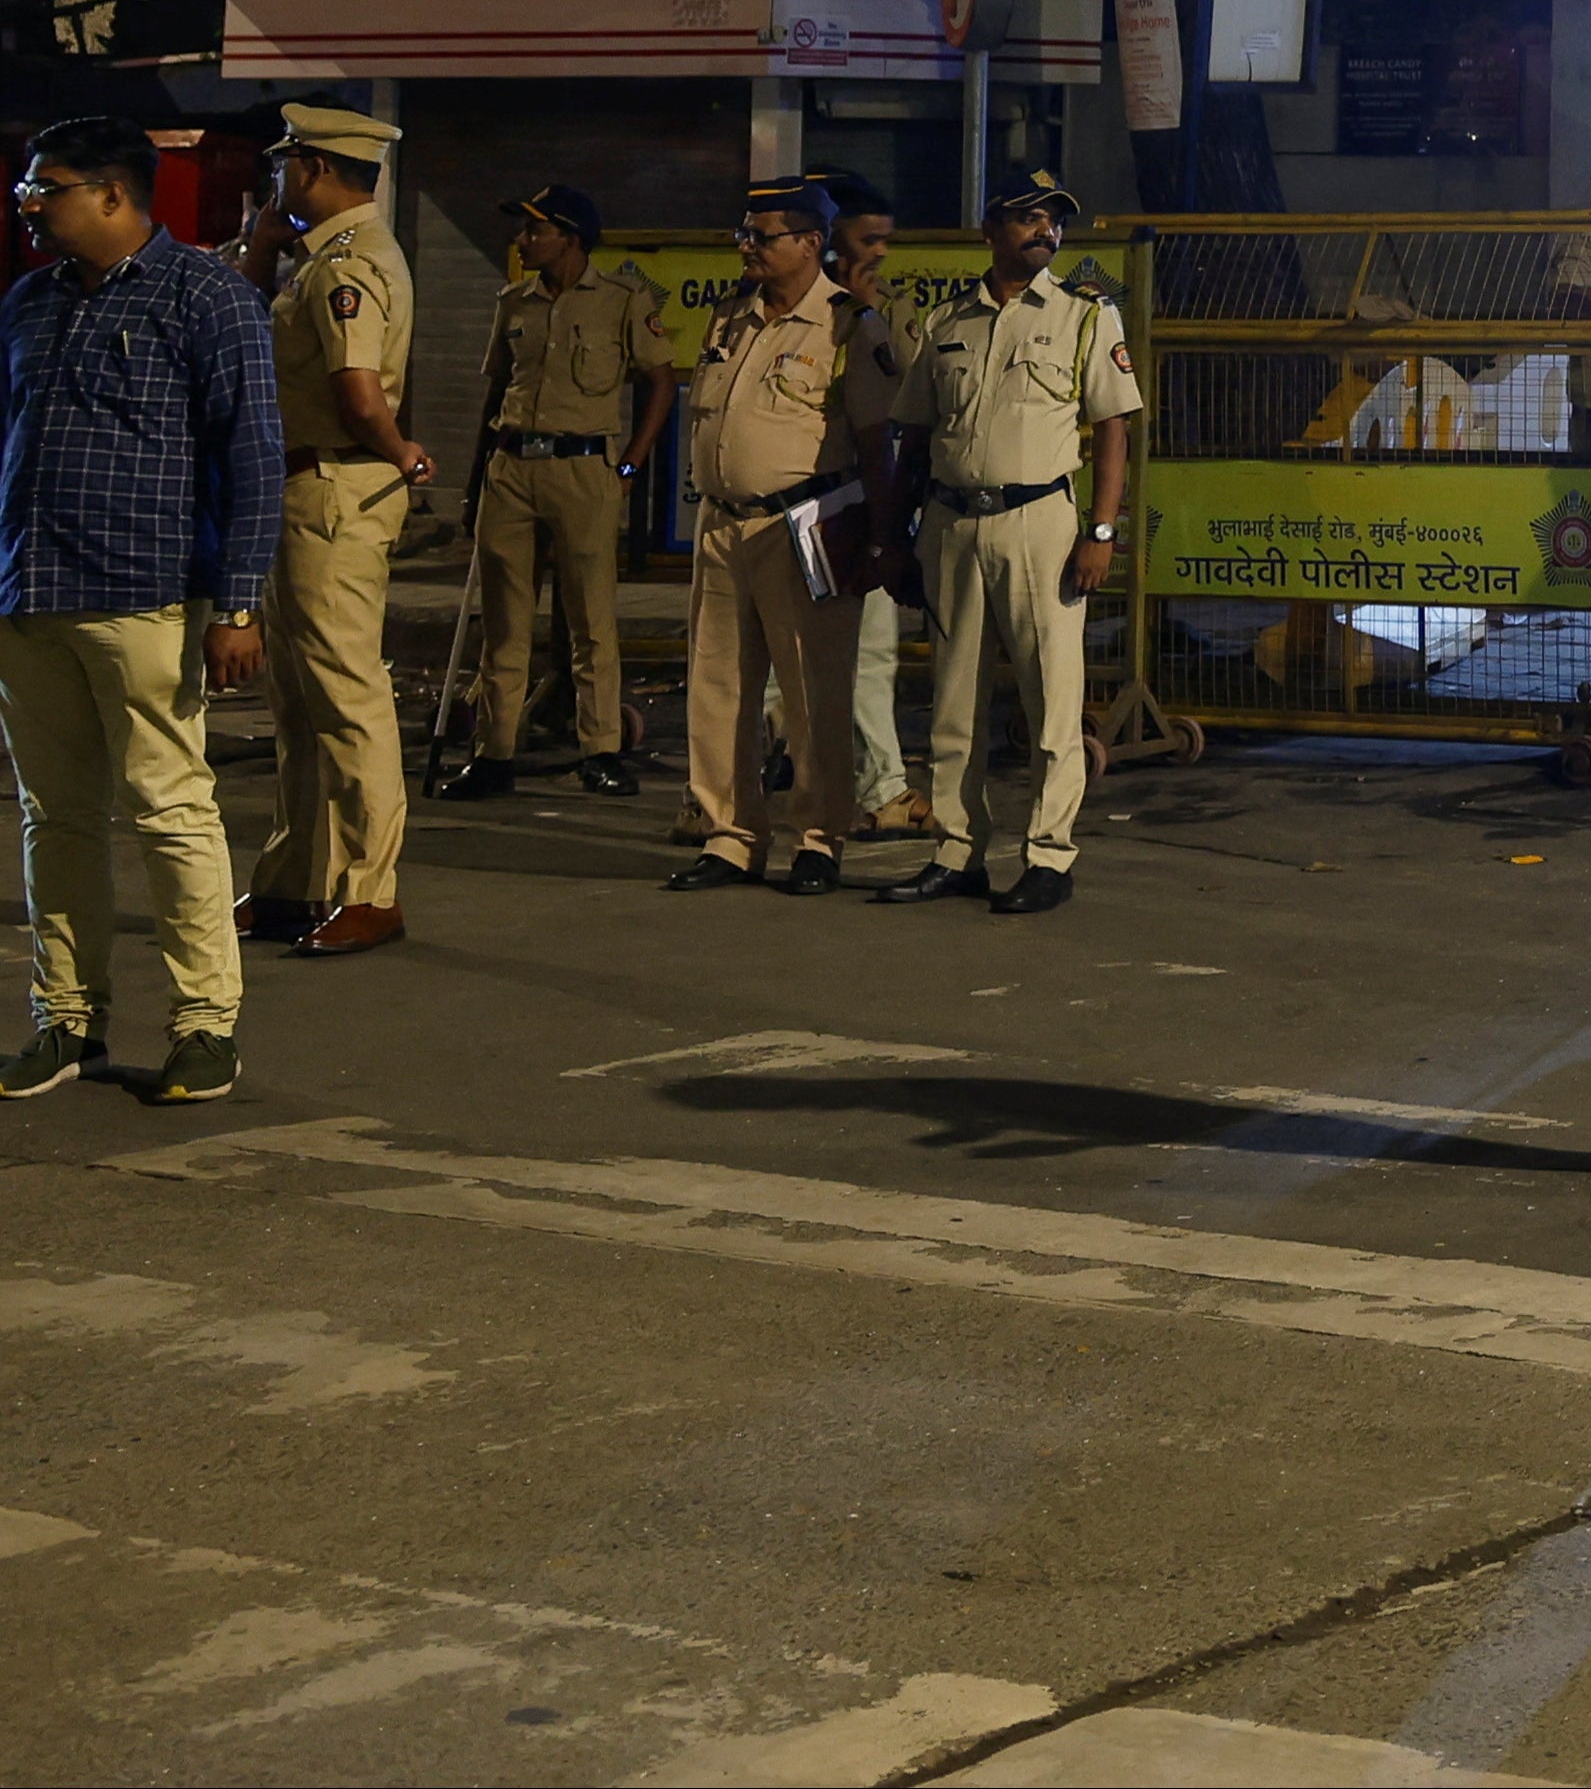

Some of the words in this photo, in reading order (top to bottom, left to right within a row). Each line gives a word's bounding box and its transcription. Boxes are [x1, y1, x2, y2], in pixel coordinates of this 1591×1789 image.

[1280, 514, 1324, 543] देसाई
[1175, 547, 1289, 589] गावदेवी
[1299, 547, 1405, 591] पोलीस
[1415, 551, 1521, 596] स्टेशन
